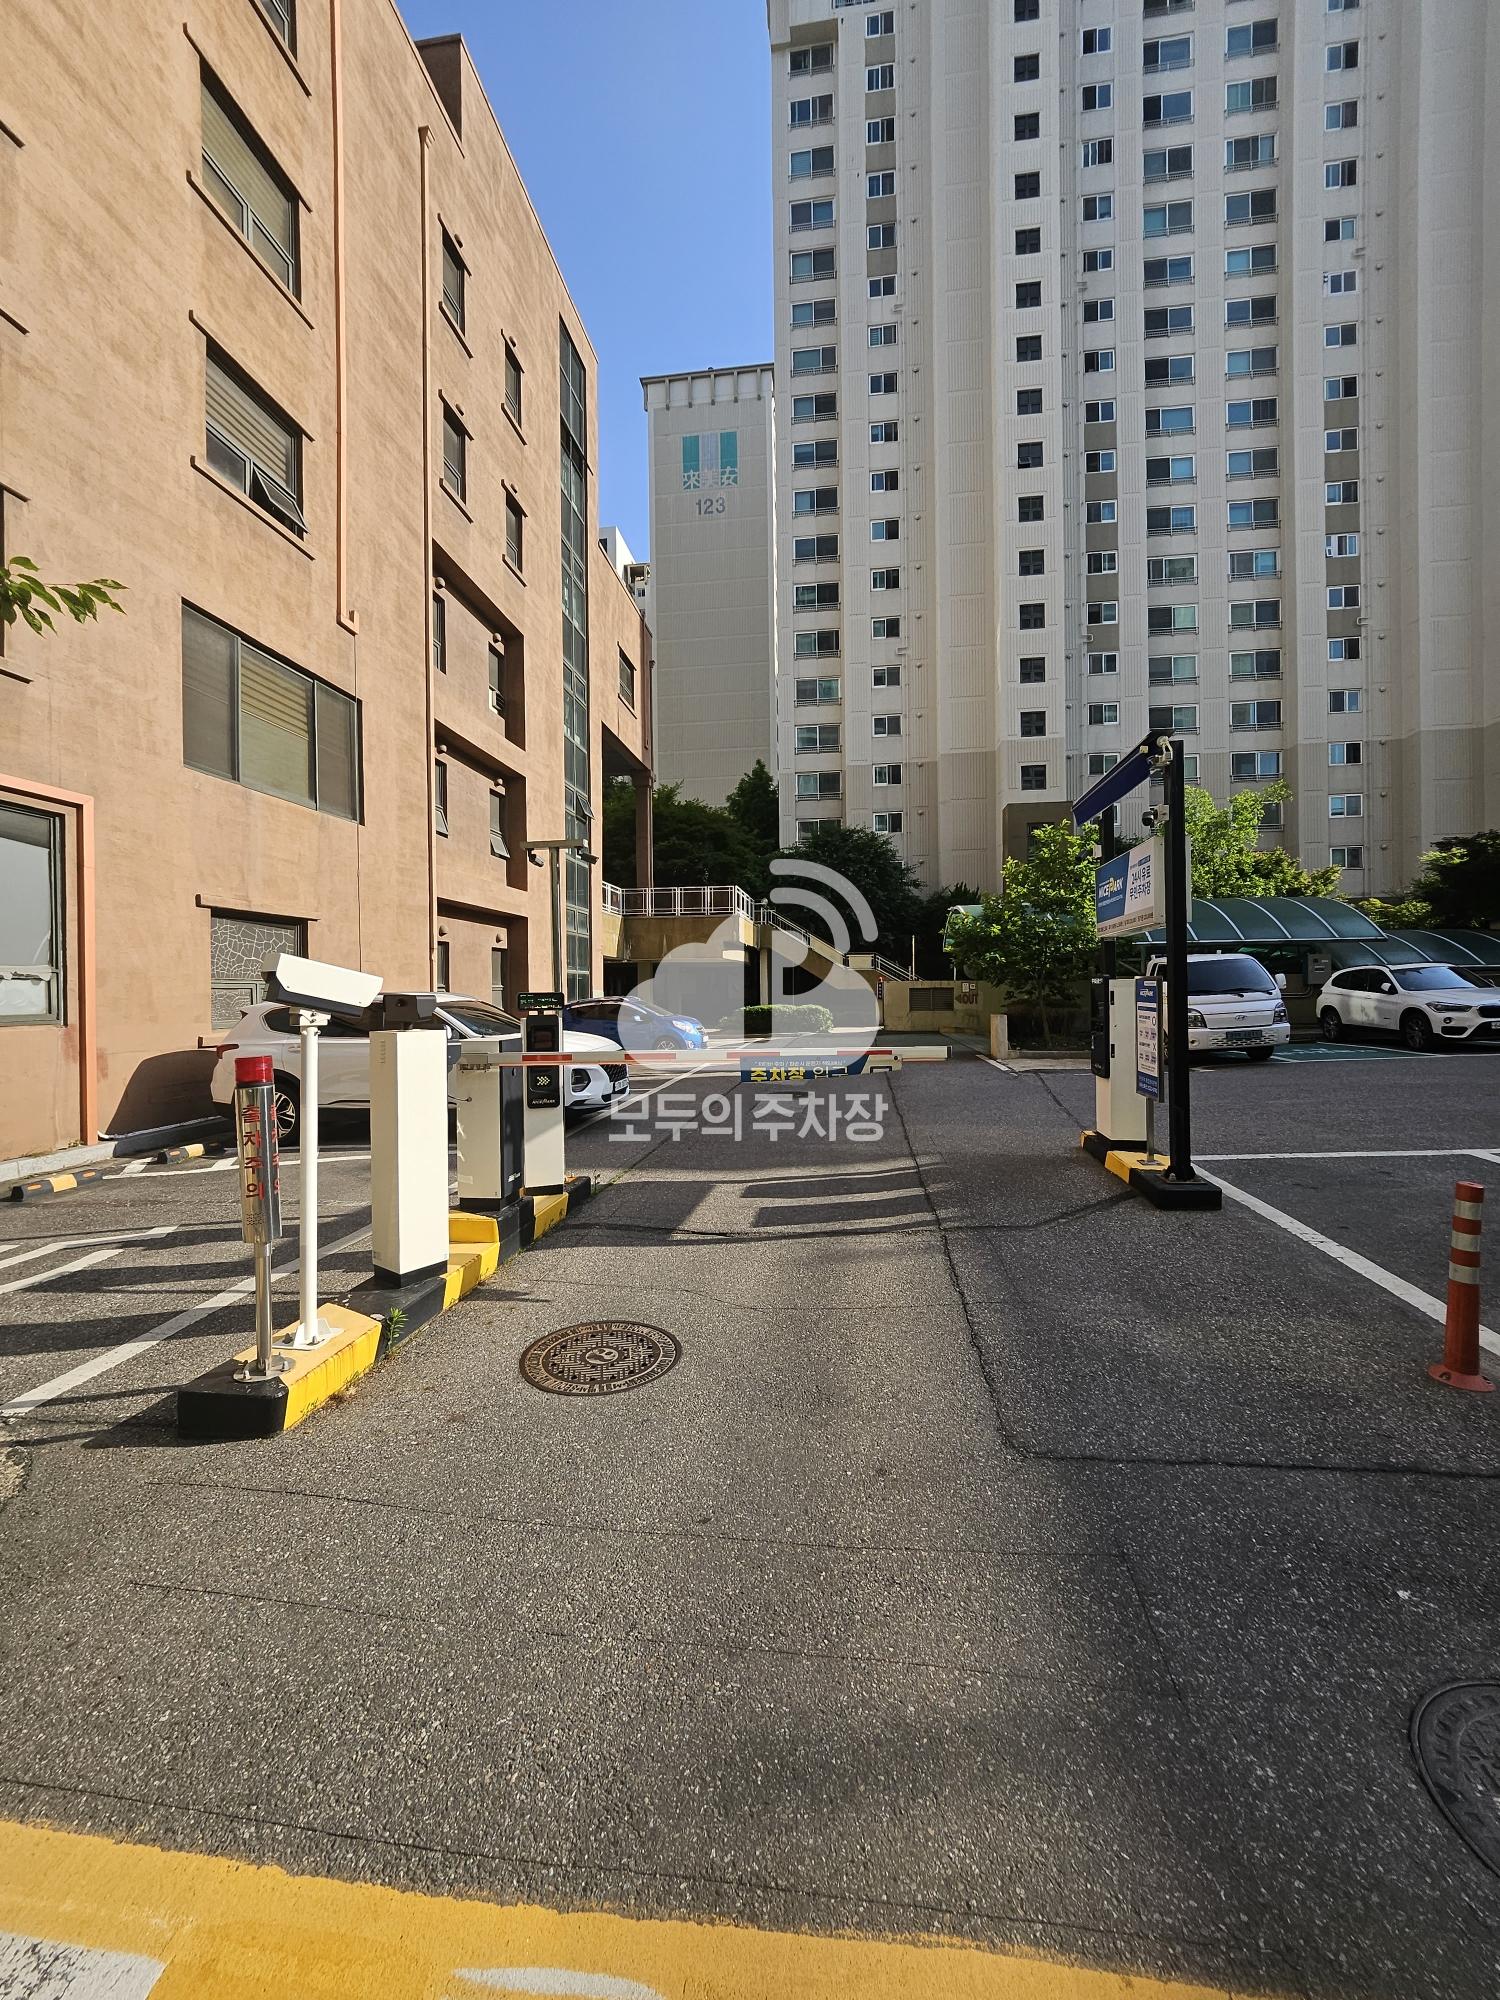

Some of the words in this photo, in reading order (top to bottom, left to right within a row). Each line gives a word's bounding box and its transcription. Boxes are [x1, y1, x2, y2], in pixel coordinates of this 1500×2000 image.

[695, 496, 726, 515] 123
[750, 1066, 805, 1082] 주차장
[241, 1104, 265, 1201] 출차주의
